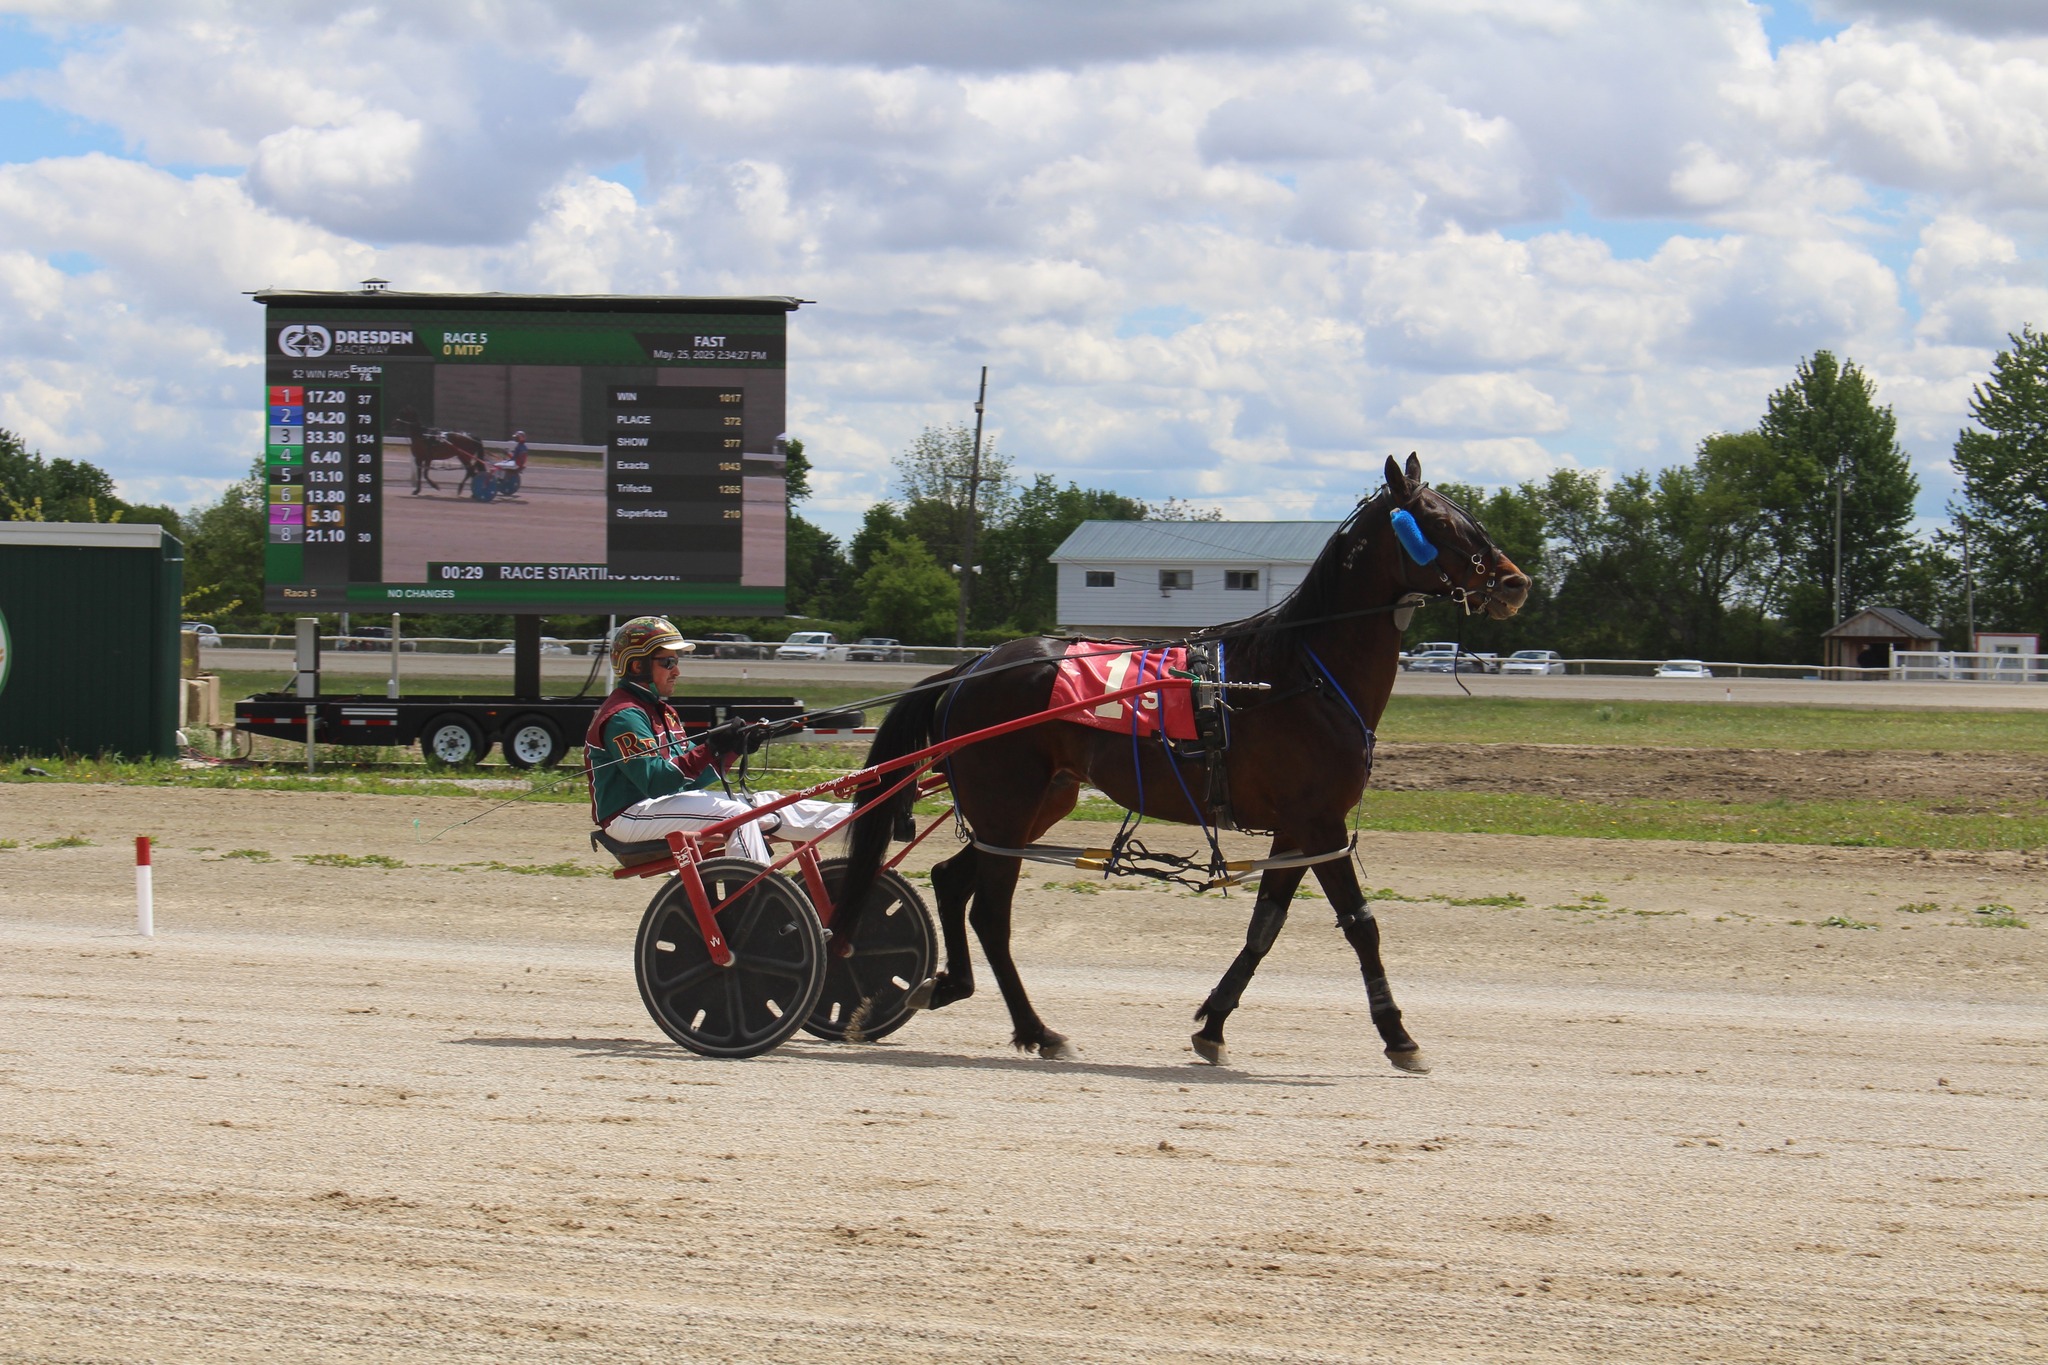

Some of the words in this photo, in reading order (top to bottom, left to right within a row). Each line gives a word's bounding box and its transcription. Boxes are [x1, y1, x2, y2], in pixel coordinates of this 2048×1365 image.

[335, 330, 413, 344] DRESDEN
[443, 332, 477, 344] RACE
[479, 332, 488, 344] 5
[694, 336, 726, 348] FAST
[335, 345, 389, 354] RACEWAY
[442, 345, 451, 355] 0
[454, 345, 484, 355] MTP
[653, 350, 676, 361] May.
[677, 350, 691, 360] 25,
[692, 350, 715, 359] 2025
[717, 351, 749, 360] 2:34:27
[751, 351, 767, 360] PM
[292, 369, 305, 379] $2
[306, 370, 326, 379] WIN
[327, 370, 350, 379] PAYS
[350, 364, 382, 373] Exacta
[282, 389, 290, 403] 1
[306, 391, 346, 403] 17.20
[357, 395, 372, 404] 37
[616, 392, 638, 401] WIN
[281, 408, 291, 423] 2
[306, 412, 346, 424] 94.20
[357, 414, 372, 424] 79
[616, 416, 651, 424] PLACE
[723, 417, 742, 426] 372
[281, 429, 290, 443] 3
[306, 431, 346, 444] 33.30
[355, 434, 375, 444] 134
[616, 438, 649, 447] SHOW
[723, 439, 742, 448] 377
[280, 448, 292, 462] 4
[310, 451, 342, 463] 6.40
[357, 454, 372, 463] 20
[616, 461, 649, 470] Exacta
[281, 467, 291, 482] 5
[308, 471, 344, 482] 13.10
[616, 484, 652, 493] Trifecta
[281, 487, 291, 502] 6
[306, 490, 346, 503] 13.80
[357, 494, 372, 503] 24
[281, 507, 291, 521] 7
[310, 510, 341, 523] 5.30
[616, 509, 668, 519] Superfecta
[281, 527, 291, 541] 8
[306, 529, 346, 542] 21.10
[441, 565, 484, 579] 00:29
[500, 566, 544, 580] RACE
[548, 566, 626, 581] STARTI
[283, 588, 309, 598] Race
[310, 588, 318, 598] 5
[387, 589, 403, 598] NO
[404, 589, 455, 599] CHANGES
[1094, 652, 1133, 720] 1
